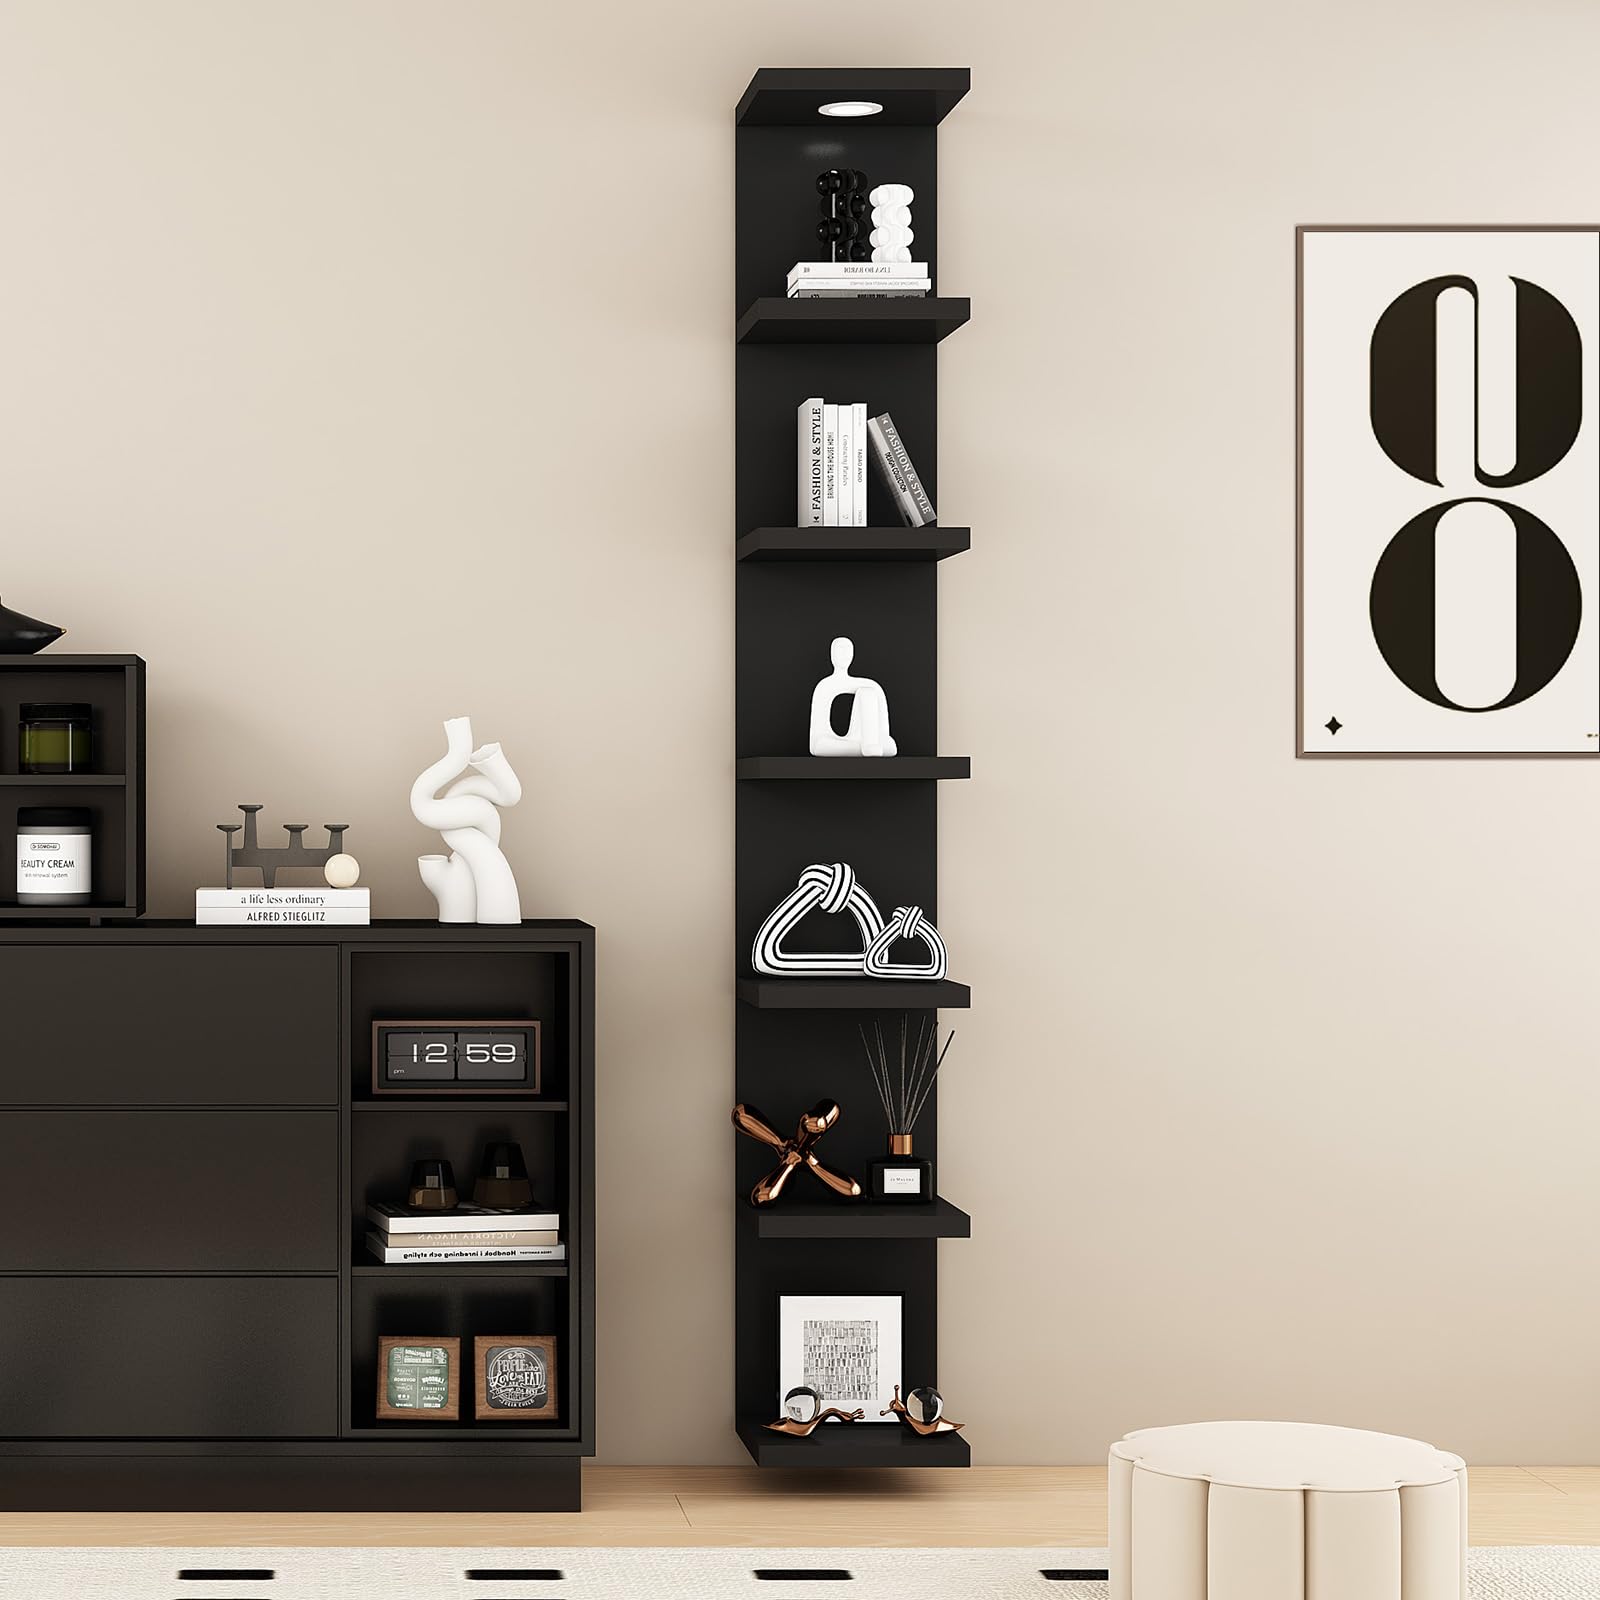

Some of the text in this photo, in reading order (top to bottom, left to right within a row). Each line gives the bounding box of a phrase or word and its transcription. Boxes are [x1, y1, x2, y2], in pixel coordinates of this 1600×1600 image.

[812, 408, 820, 510] FASHION & STYLE
[885, 452, 908, 493] DESIGN COLLECTION
[886, 428, 931, 514] FASHION & STYLE
[21, 860, 75, 868] BEAUTY CREAM
[249, 894, 264, 904] life
[266, 894, 283, 904] less
[285, 894, 326, 906] ordinary
[247, 912, 325, 921] ALFRED STIEGLITZ
[413, 1043, 516, 1063] 12 59
